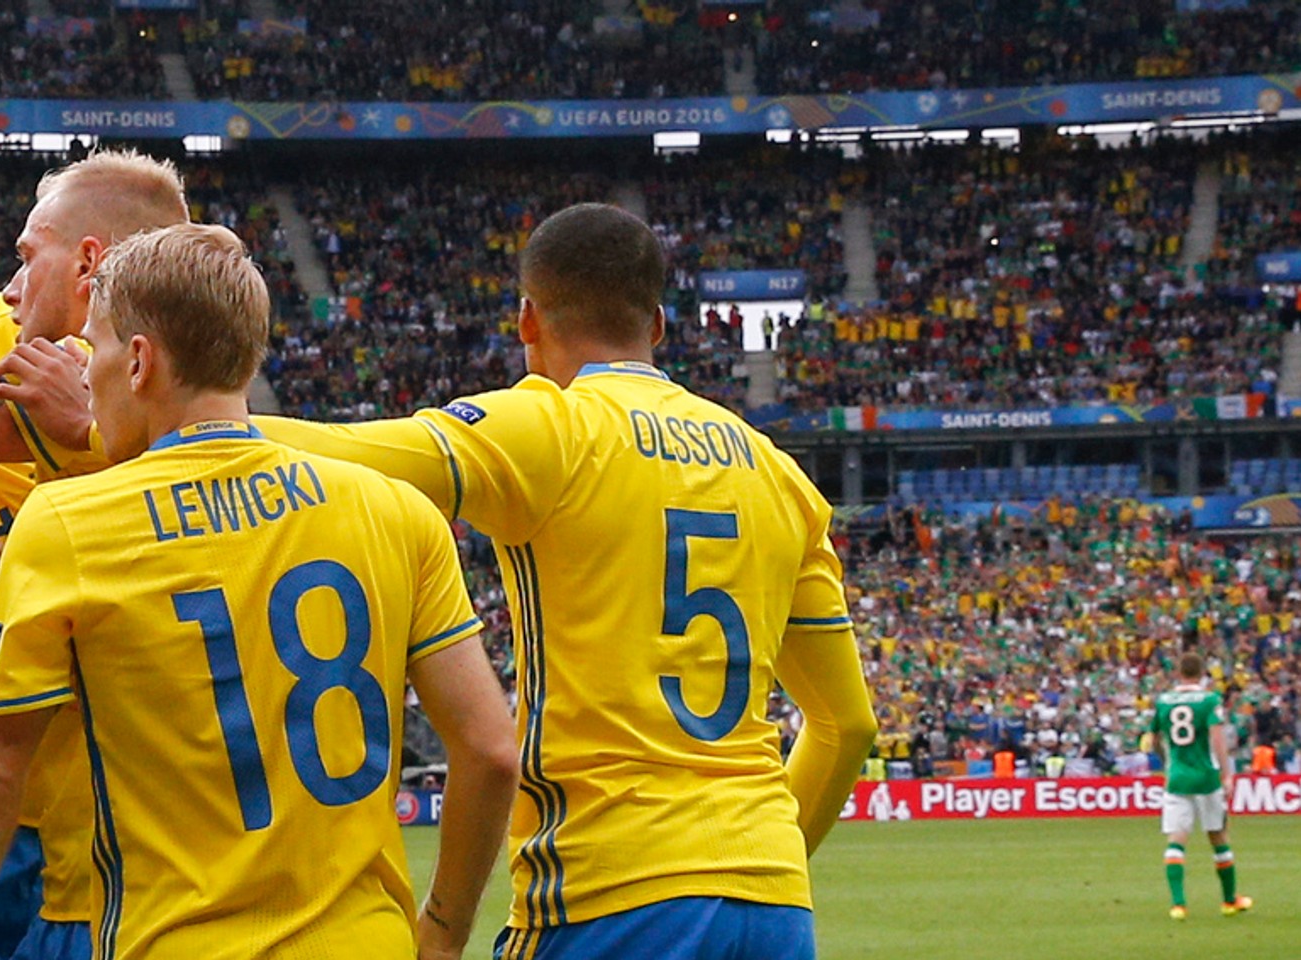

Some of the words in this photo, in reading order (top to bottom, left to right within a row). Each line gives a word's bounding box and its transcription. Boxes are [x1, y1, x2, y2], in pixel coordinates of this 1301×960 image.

[559, 110, 612, 126] UEFA
[616, 109, 671, 125] EURO
[675, 107, 726, 124] 2016
[1102, 87, 1222, 109] SAINT-DENIS
[61, 110, 176, 127] SAINT-DENIS
[631, 409, 756, 471] OLSSON
[941, 411, 1053, 429] SAINT-DENIS
[143, 460, 327, 542] LEWICKI
[658, 507, 752, 742] 5
[171, 559, 391, 832] 18
[1169, 704, 1196, 746] 8
[920, 782, 1026, 818] Player
[1034, 780, 1162, 812] Escorts
